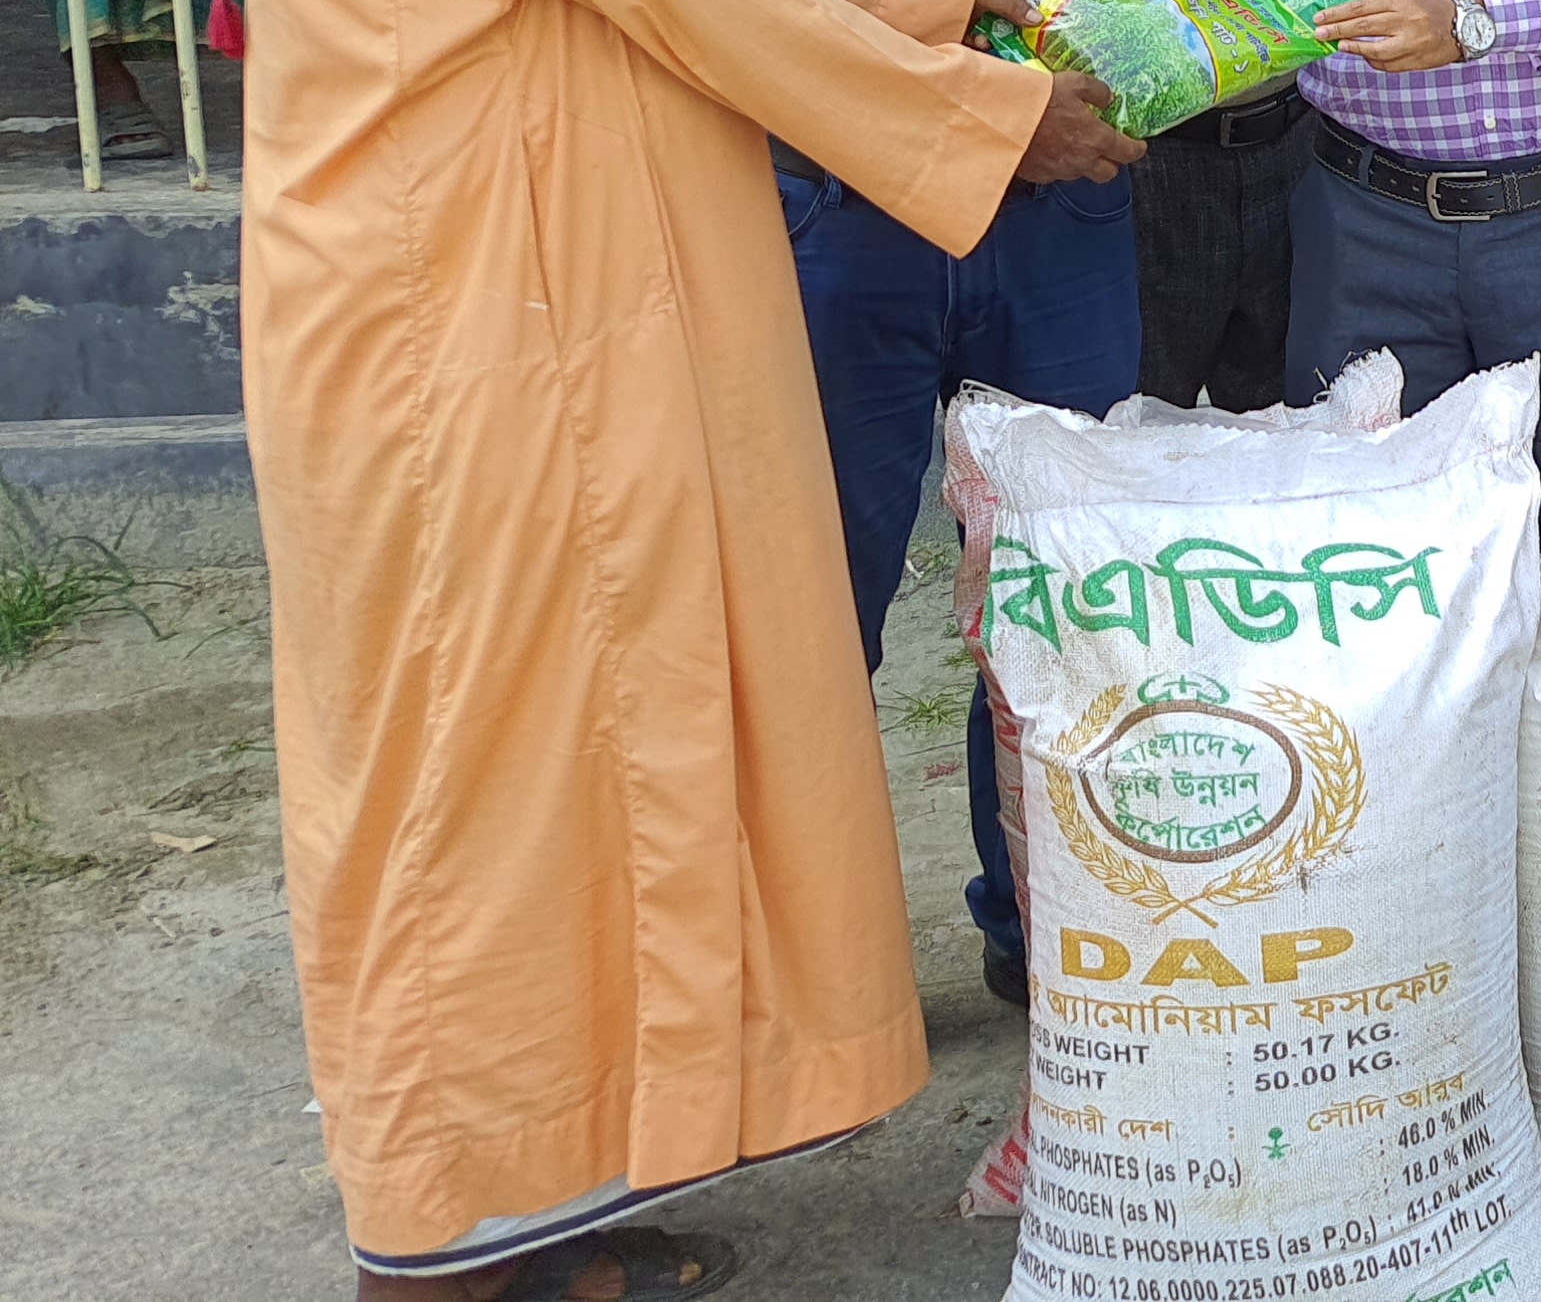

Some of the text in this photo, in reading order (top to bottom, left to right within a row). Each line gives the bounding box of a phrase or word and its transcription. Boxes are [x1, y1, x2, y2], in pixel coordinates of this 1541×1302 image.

[980, 536, 1443, 657] বিএডিসি
[1117, 730, 1255, 766] বাংলাদেশ
[1170, 767, 1260, 807] উন্নয়ন
[1060, 926, 1355, 987] DAP
[1293, 962, 1454, 1025] ফসফেট
[1054, 1032, 1149, 1064] WEIGHT
[1252, 1033, 1334, 1065] 50.17
[1347, 1021, 1400, 1051] KG.
[1036, 1050, 1400, 1093] WEIGHT 50.00 KG.
[1118, 1118, 1175, 1142] দেশ
[1307, 1094, 1389, 1132] সৌদি
[1040, 1135, 1139, 1181] PHOSPHATES
[1146, 1157, 1176, 1187] (as
[1398, 1118, 1435, 1148] 46.0
[1040, 1178, 1113, 1220] NITROGEN
[1120, 1197, 1148, 1228] (as
[1402, 1155, 1439, 1187] 18.0
[1046, 1222, 1116, 1259] SOLUBLE
[1122, 1237, 1270, 1264] PHOSPHATES
[1278, 1233, 1311, 1263] (as
[1072, 1272, 1103, 1300] NO:
